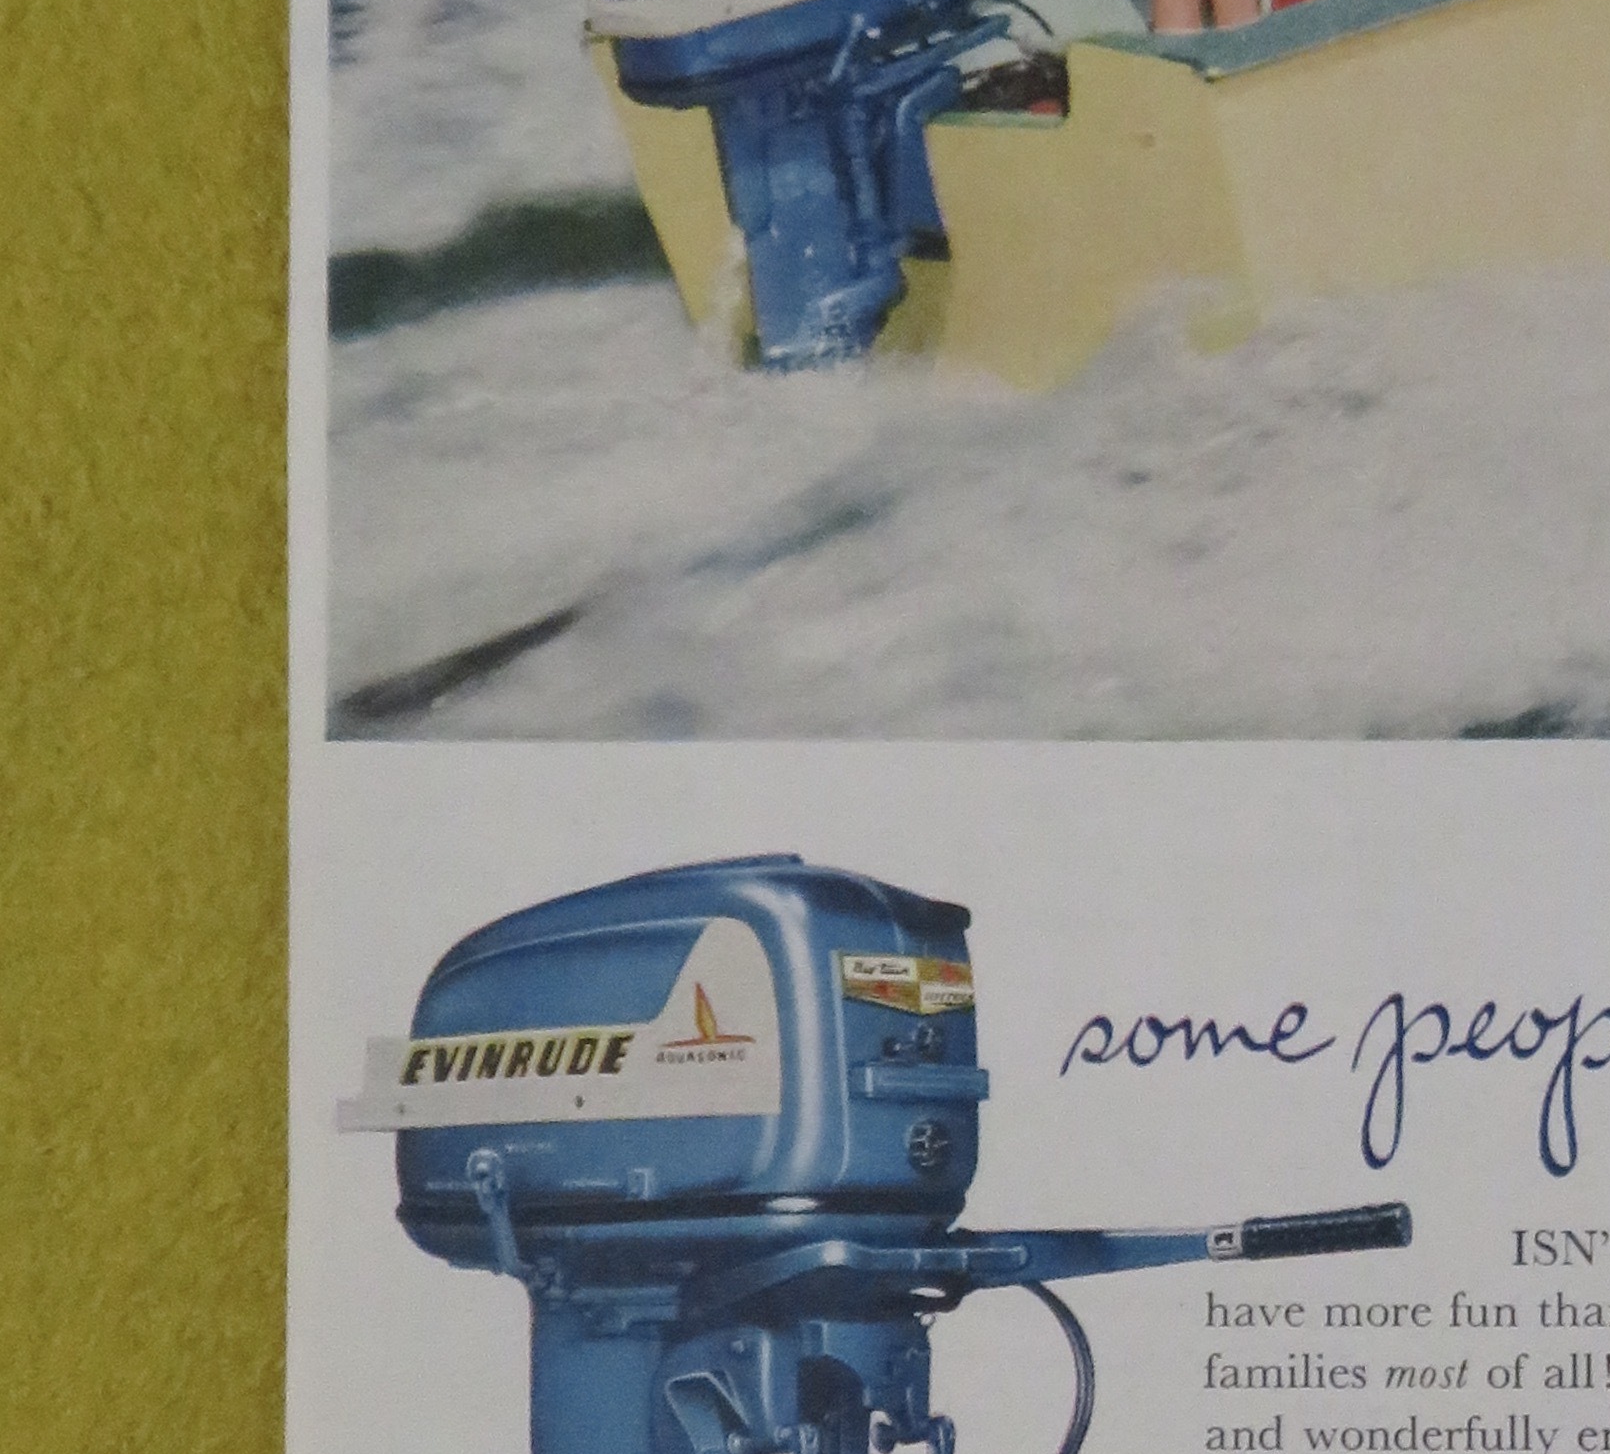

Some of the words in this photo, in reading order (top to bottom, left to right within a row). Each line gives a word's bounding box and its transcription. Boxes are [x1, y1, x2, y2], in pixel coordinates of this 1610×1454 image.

[400, 1033, 635, 1085] EVINRUDE
[1060, 1002, 1336, 1076] some
[1204, 1353, 1367, 1389] families
[1386, 1359, 1468, 1389] most
[1487, 1353, 1529, 1389] of
